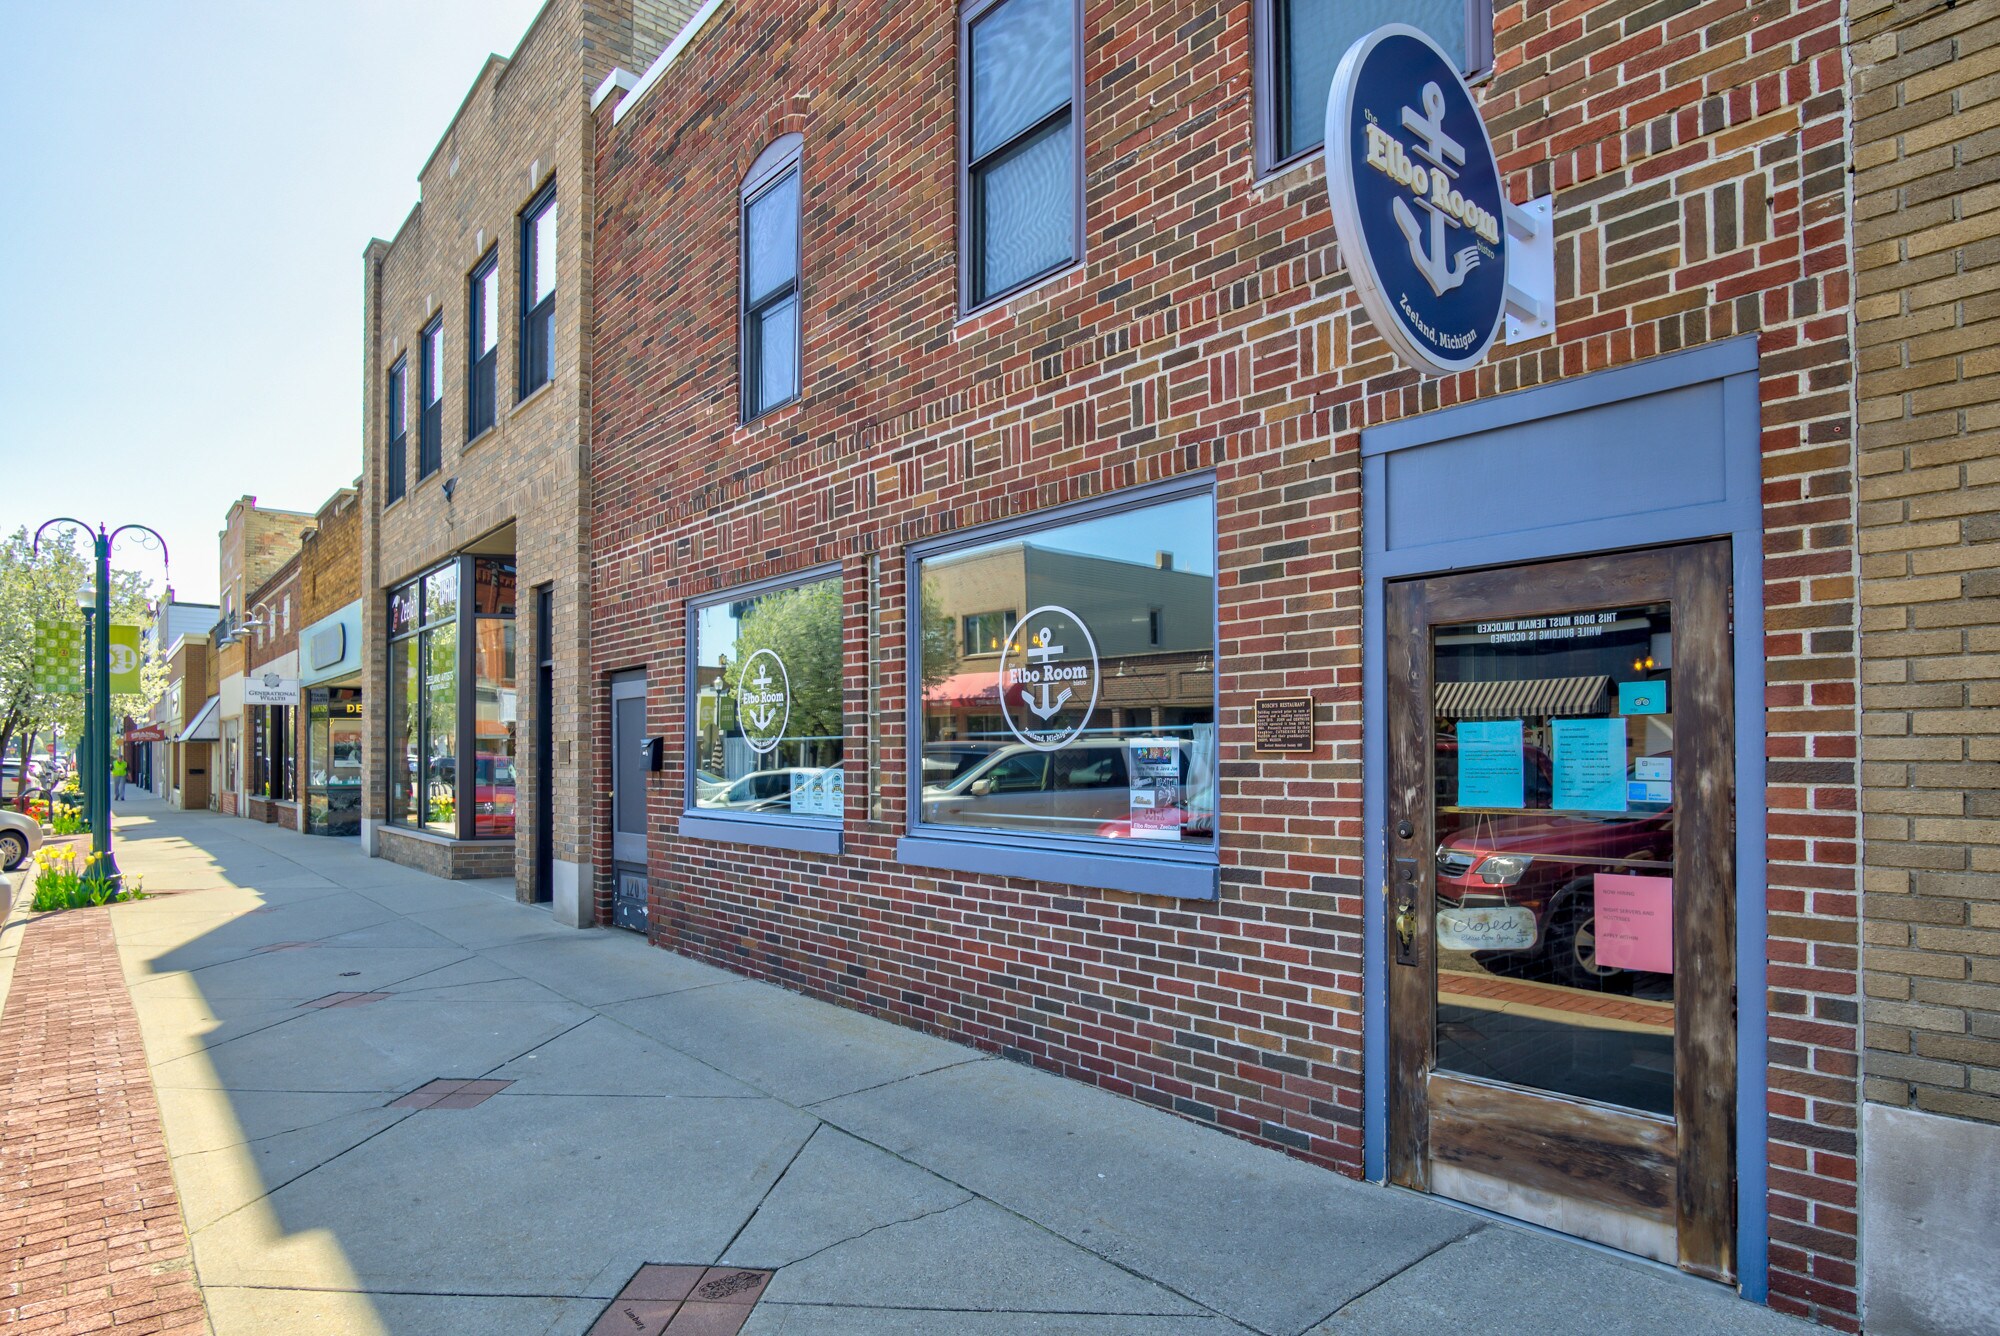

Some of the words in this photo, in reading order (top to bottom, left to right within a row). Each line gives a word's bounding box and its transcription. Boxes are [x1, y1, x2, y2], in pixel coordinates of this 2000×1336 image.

[1364, 108, 1378, 125] the
[1365, 123, 1429, 195] Elbo
[1430, 167, 1500, 245] Room
[1476, 240, 1495, 260] bistro
[1399, 292, 1438, 347] Zeeland,
[1439, 327, 1478, 350] Michigan
[1010, 668, 1040, 684] Elbo
[1043, 665, 1087, 681] Room
[743, 692, 760, 704] Elbo
[761, 691, 784, 703] Room
[1046, 726, 1072, 742] Michigan
